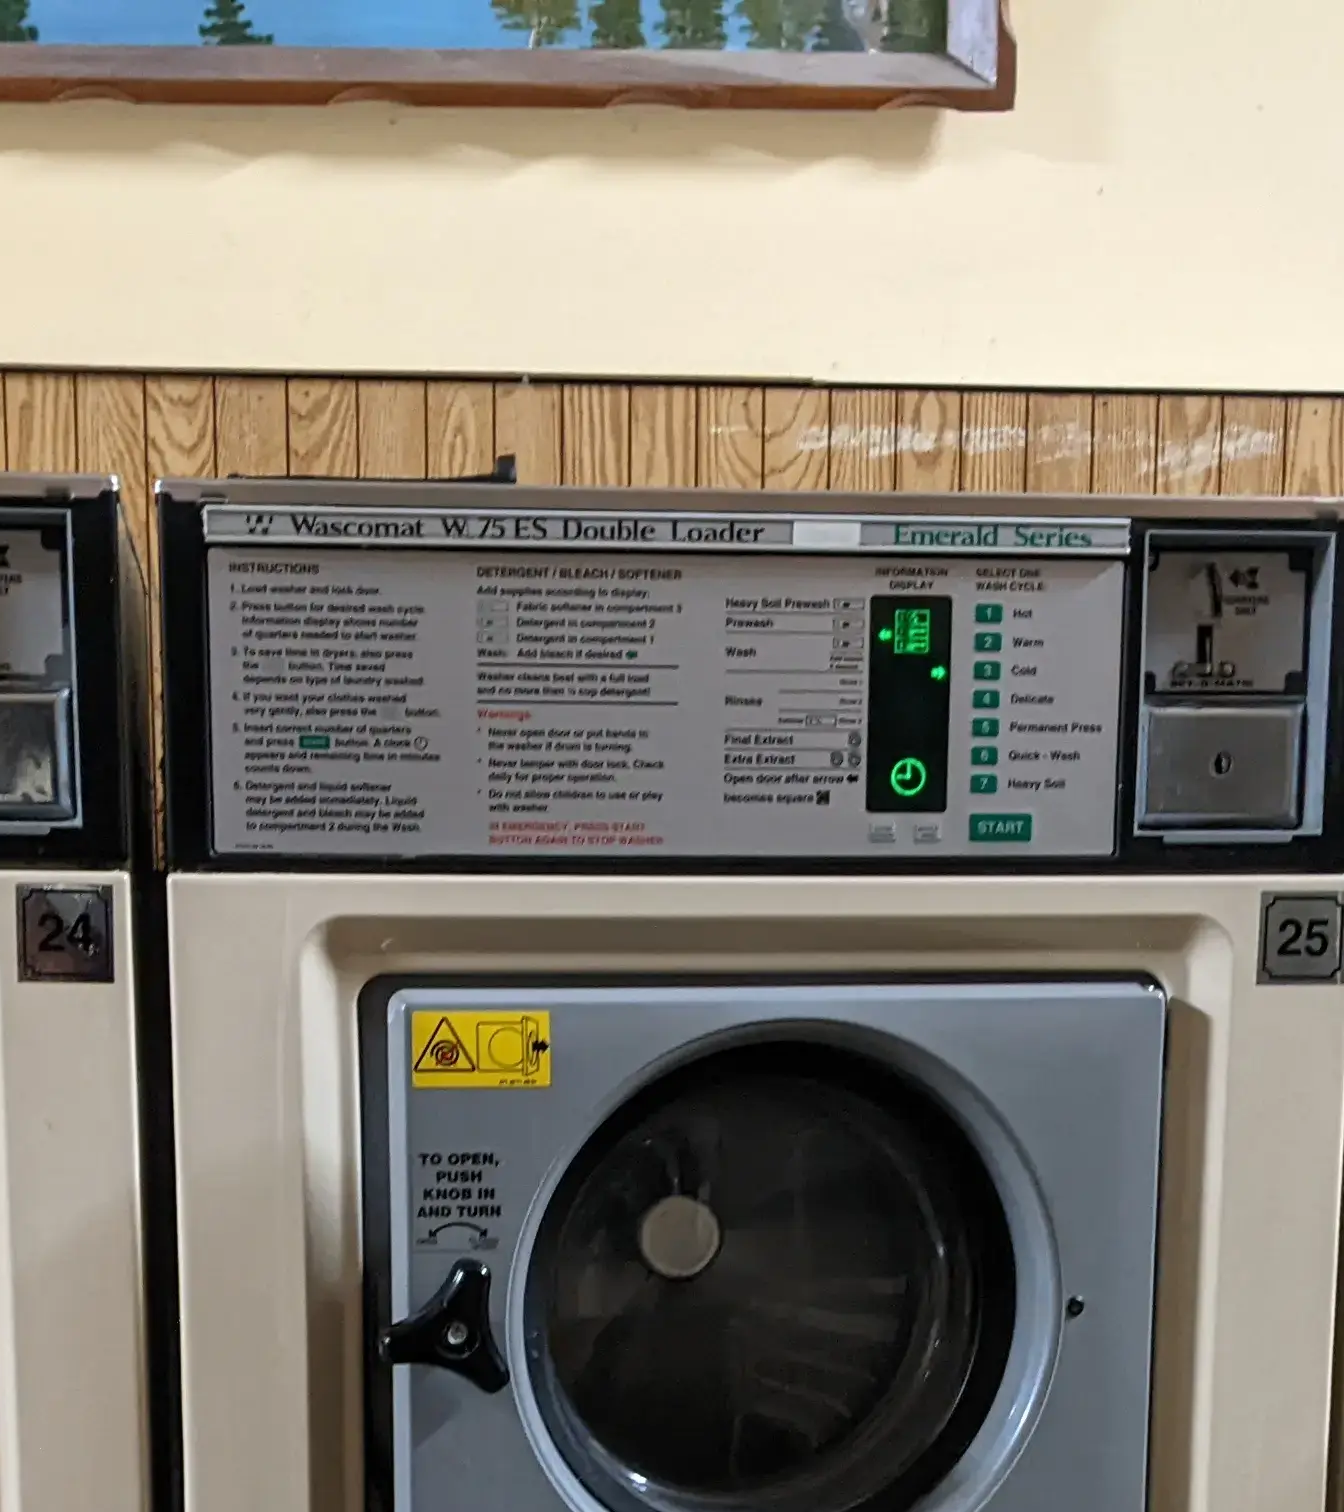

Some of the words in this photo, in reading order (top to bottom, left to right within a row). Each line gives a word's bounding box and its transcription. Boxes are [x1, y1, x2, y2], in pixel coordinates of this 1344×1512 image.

[291, 514, 424, 538] Wascomat
[563, 520, 656, 543] Double
[671, 520, 764, 543] Loader
[895, 523, 999, 548] Emerald
[1014, 526, 1092, 549] Series
[229, 563, 320, 575] INSTRUCTIONS
[477, 567, 549, 579] DETERGENT
[559, 568, 607, 579] BLEACH
[619, 569, 682, 580] SOFTENER
[875, 567, 948, 577] INFORMATION
[976, 568, 1015, 578] SELECT
[889, 580, 933, 591] DISPLAY
[976, 581, 1007, 591] WASH
[725, 599, 757, 611] Heavy
[761, 599, 781, 609] Soil
[785, 599, 830, 609] Prewash
[985, 608, 992, 619] 1
[1013, 609, 1032, 619] Hot
[725, 618, 773, 628] Prewash
[984, 636, 993, 648] 2
[1013, 638, 1044, 647] Warm
[983, 665, 992, 677] 3
[1011, 666, 1037, 676] Cold
[982, 693, 991, 705] 4
[1010, 694, 1054, 704] Delicate
[1010, 722, 1068, 733] Permanent
[1071, 723, 1102, 734] Press
[724, 735, 751, 745] Final
[754, 735, 793, 745] Extract
[724, 754, 752, 764] Extra
[756, 754, 795, 765] Extract
[1009, 751, 1040, 762] Quick
[1050, 752, 1080, 762] Wash
[724, 773, 753, 786] Open
[756, 774, 782, 784] door
[784, 774, 810, 784] after
[813, 775, 844, 784] arrow
[980, 778, 988, 789] 7
[1008, 779, 1041, 791] Heavy
[1044, 779, 1065, 789] Soil
[977, 821, 1024, 834] START
[38, 913, 100, 952] 24
[1277, 918, 1329, 956] 25
[418, 1153, 442, 1166] TO
[447, 1153, 500, 1168] OPEN,
[436, 1171, 482, 1183] PUSH
[423, 1187, 472, 1200] KNOB
[477, 1187, 495, 1200] IN
[417, 1205, 452, 1218] AND
[457, 1205, 501, 1218] TURN
